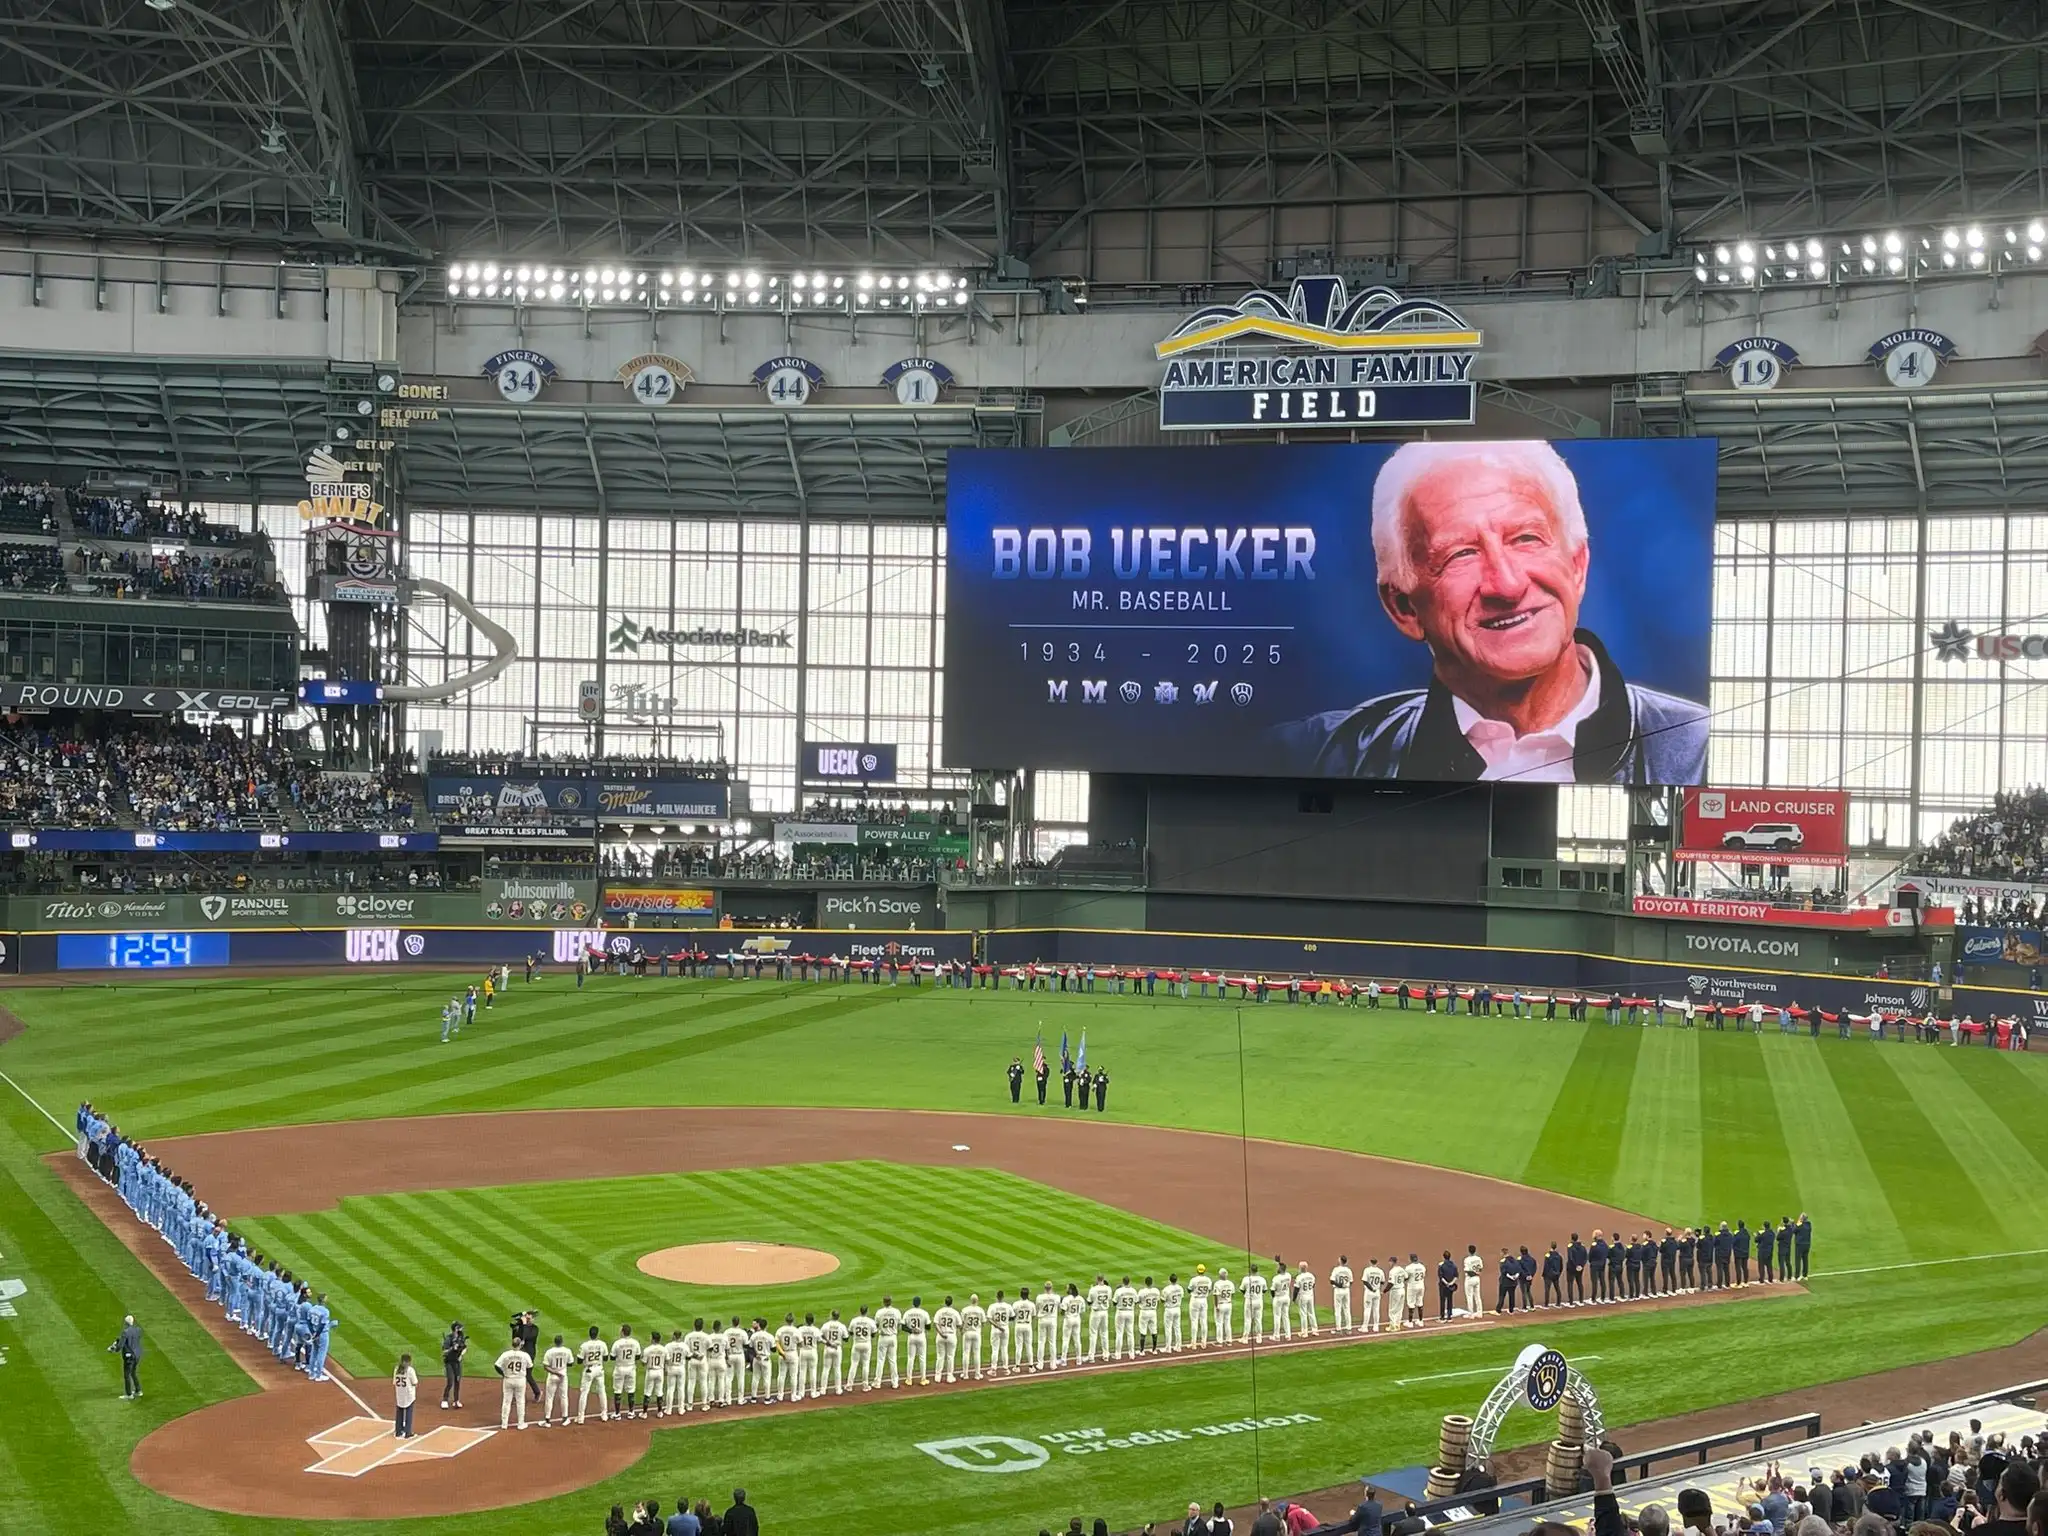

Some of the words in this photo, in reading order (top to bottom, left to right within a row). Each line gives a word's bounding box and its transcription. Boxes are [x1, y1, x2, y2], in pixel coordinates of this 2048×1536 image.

[1735, 338, 1780, 352] YOUNT
[1881, 331, 1943, 349] MOLITOR
[495, 351, 546, 366] FINGERS
[627, 355, 681, 372] ROBINSON
[770, 357, 808, 370] AARON
[900, 358, 935, 371] SELIG
[1899, 350, 1918, 378] 4
[1164, 357, 1338, 389] AMERICAN
[1349, 353, 1477, 385] FAMILY
[1738, 358, 1775, 386] 19
[503, 368, 538, 395] 34
[637, 374, 671, 398] 42
[771, 375, 805, 399] 44
[398, 384, 449, 400] GONE!
[910, 378, 926, 403] 1
[1252, 389, 1377, 420] FIELD
[380, 409, 402, 419] GET
[404, 408, 439, 420] OUTTA
[380, 418, 411, 428] HERE
[355, 440, 377, 450] GET
[379, 440, 396, 451] UP
[343, 461, 365, 471] GET
[312, 483, 371, 498] BERNIE'S
[297, 495, 385, 524] CHALET
[991, 527, 1092, 580] BOB
[1110, 527, 1316, 581] UECKER
[1072, 590, 1110, 611] MR.
[1119, 590, 1232, 612] BASEBALL
[1020, 642, 1107, 663] 1934
[1187, 643, 1282, 665] 2025
[19, 686, 125, 708] ROUND
[582, 685, 599, 697] Lite
[217, 695, 290, 711] GOLF
[818, 748, 859, 776] UECK
[459, 786, 473, 796] GO
[598, 790, 653, 812] Miller
[626, 803, 655, 815] TIME,
[656, 804, 717, 815] MILWAUKEE
[1731, 801, 1771, 814] LAND
[1775, 801, 1836, 816] CRUISER
[465, 827, 489, 835] GREAT
[490, 827, 516, 836] TASTE.
[517, 828, 536, 836] LESS
[537, 828, 569, 836] FILLING.
[865, 830, 899, 840] POWER
[901, 831, 931, 841] ALLEY
[1675, 851, 1710, 861] COURTESY
[1711, 853, 1721, 861] OF
[1722, 854, 1741, 862] YOUR
[1742, 855, 1782, 863] WISCONSIN
[1783, 856, 1810, 864] TOYOTA
[1811, 857, 1842, 865] DEALERS
[500, 881, 575, 900] Johnsonville
[123, 902, 166, 911] Handmade
[231, 898, 289, 909] FANDUEL
[357, 895, 415, 912] clover
[610, 891, 673, 911] Surfside
[879, 898, 921, 914] Save
[46, 901, 96, 919] Tito's
[231, 909, 257, 917] SPORTS
[257, 909, 289, 917] NETWORK
[1638, 899, 1690, 913] TOYOTA
[1691, 902, 1768, 919] TERRITORY
[110, 933, 192, 967] 12:54
[345, 929, 400, 962] UECK
[553, 930, 607, 963] UECK
[851, 944, 885, 956] Fleet
[901, 945, 936, 956] Farm
[1303, 943, 1318, 952] 400
[1686, 935, 1799, 957] TOYOTA.COM
[1964, 936, 2002, 955] Culver's
[1710, 977, 1778, 993] Northwestern
[1710, 987, 1745, 999] Mutual
[1864, 992, 1905, 1006] Johnson
[1871, 1004, 1913, 1016] Controls
[1369, 1274, 1380, 1284] 70
[1414, 1272, 1424, 1282] 23
[1197, 1285, 1208, 1295] 59
[1220, 1289, 1231, 1299] 65
[1250, 1284, 1261, 1295] 40
[1097, 1294, 1108, 1305] 52
[1122, 1297, 1134, 1307] 53
[1145, 1297, 1157, 1308] 56
[1042, 1303, 1055, 1314] 47
[1070, 1304, 1080, 1314] 51
[994, 1311, 1007, 1322] 36
[1018, 1310, 1030, 1320] 37
[882, 1318, 895, 1329] 29
[910, 1317, 920, 1328] 31
[940, 1317, 953, 1328] 32
[967, 1316, 980, 1327] 33
[828, 1330, 838, 1341] 15
[855, 1326, 868, 1337] 26
[693, 1341, 700, 1352] 5
[729, 1337, 737, 1347] 2
[756, 1341, 763, 1351] 6
[783, 1335, 790, 1347] 9
[803, 1335, 813, 1347] 13
[713, 1343, 720, 1353] 3
[587, 1351, 601, 1362] 22
[622, 1349, 632, 1360] 12
[672, 1352, 682, 1363] 18
[507, 1361, 522, 1372] 49
[555, 1357, 563, 1368] 11
[651, 1355, 661, 1367] 10
[1531, 1354, 1565, 1377] MILWAUKEE
[395, 1376, 407, 1387] 25
[1039, 1427, 1107, 1444] uw
[1062, 1428, 1193, 1456] credit
[1191, 1410, 1323, 1437] union
